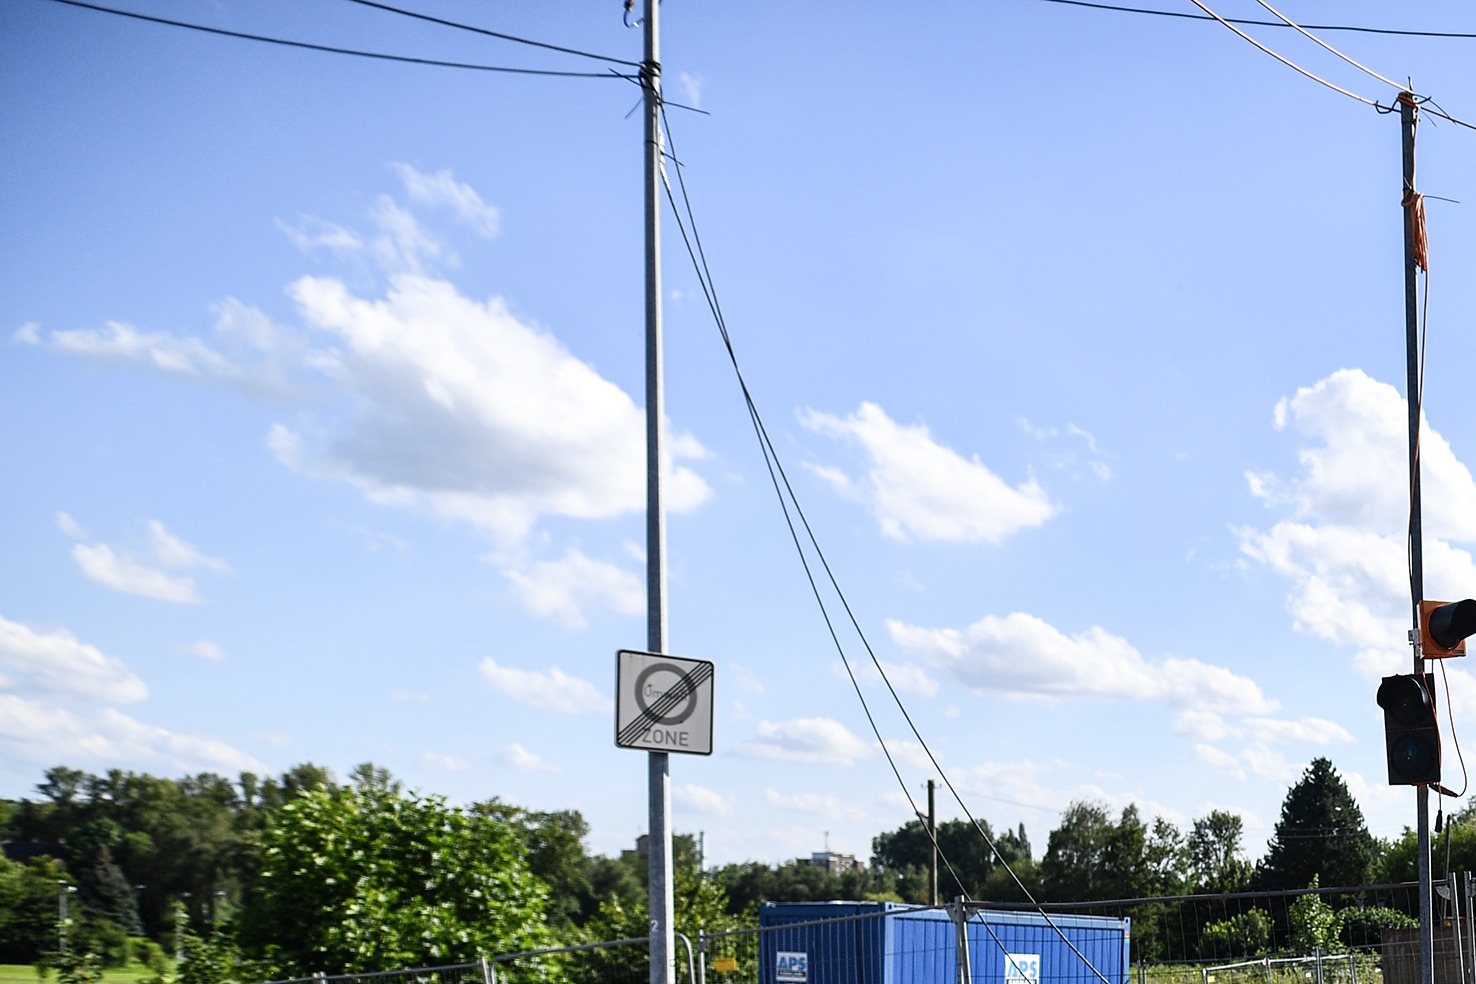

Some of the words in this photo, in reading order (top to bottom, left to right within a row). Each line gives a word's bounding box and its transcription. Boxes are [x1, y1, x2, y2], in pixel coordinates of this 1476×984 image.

[642, 729, 689, 747] ZONE
[651, 919, 658, 932] 2
[779, 956, 806, 969] APS
[1007, 960, 1037, 978] APS
